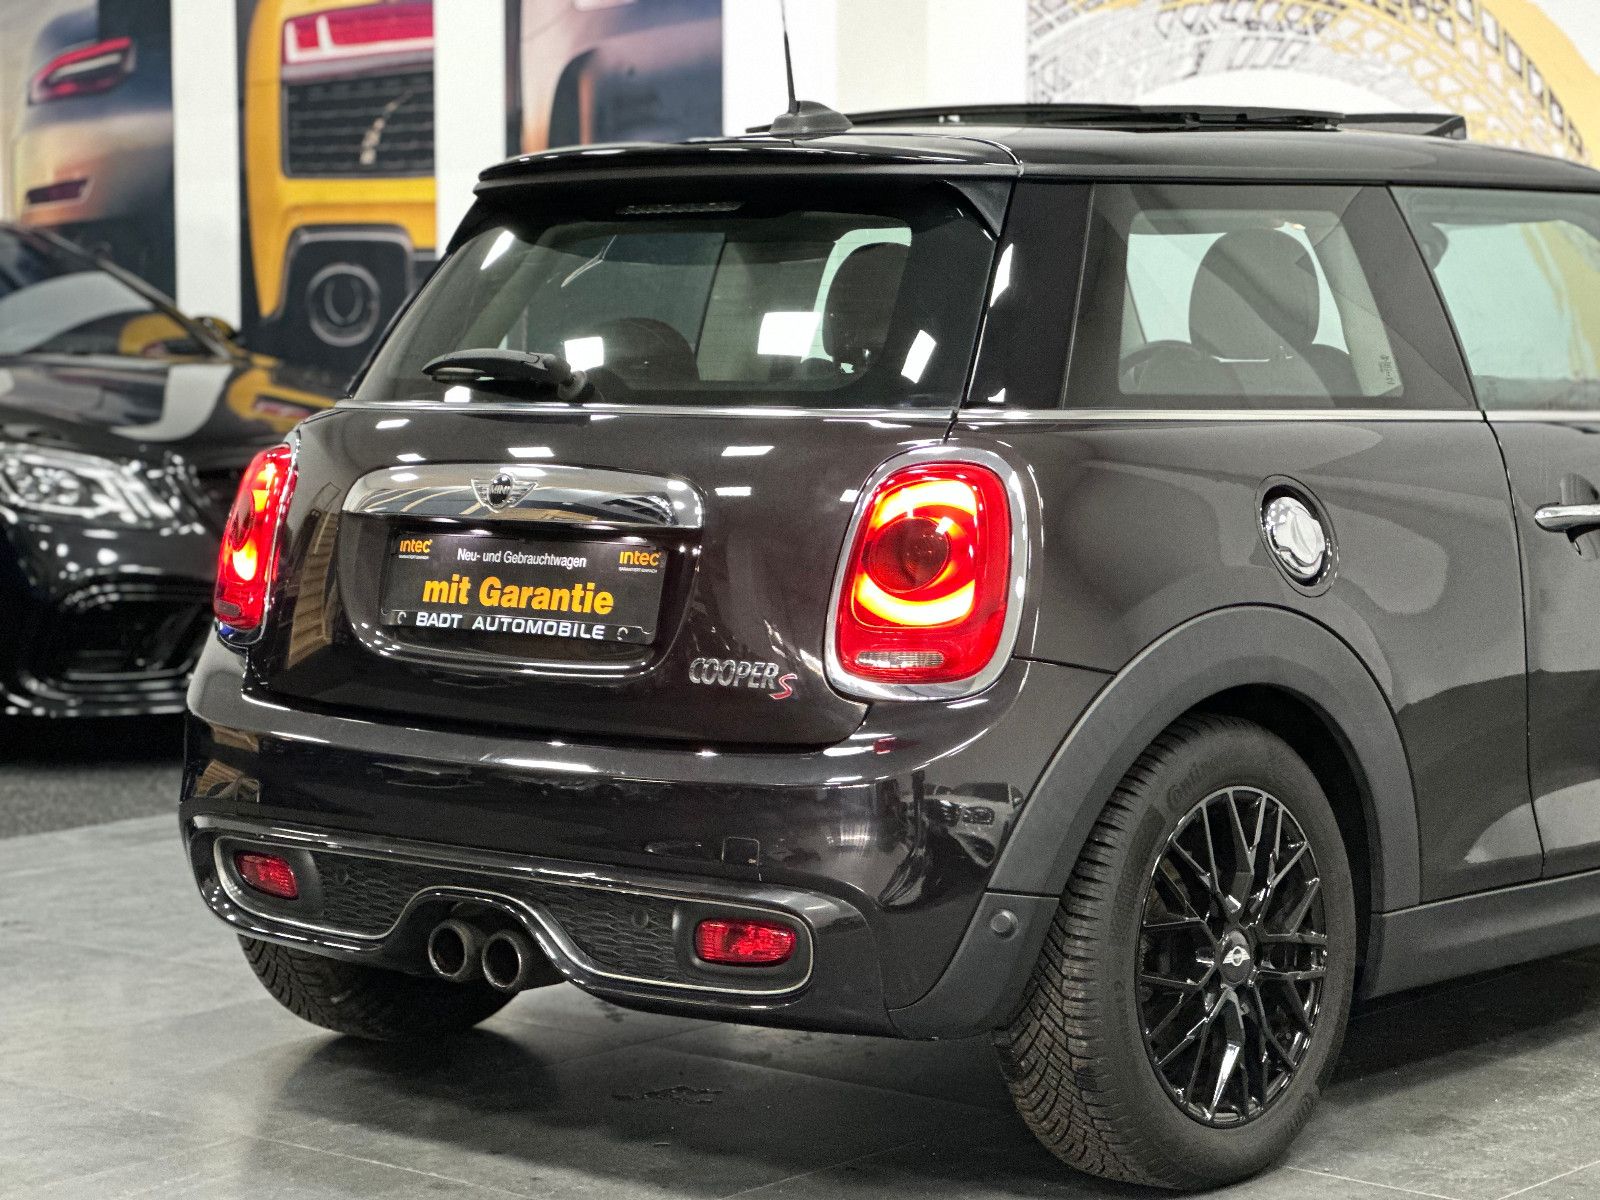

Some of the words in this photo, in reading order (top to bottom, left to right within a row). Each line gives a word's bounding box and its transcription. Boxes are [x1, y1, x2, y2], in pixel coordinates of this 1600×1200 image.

[399, 539, 432, 553] intec
[457, 547, 480, 561] Neu-
[482, 550, 501, 563] und
[503, 550, 587, 570] Gebrauchtwagen
[619, 550, 661, 566] intec
[422, 573, 471, 605] mit
[479, 576, 614, 615] Garantie
[415, 611, 463, 629] BADT
[472, 615, 606, 640] AUTOMOBILE
[688, 657, 780, 690] COOPER
[769, 672, 798, 700] S
